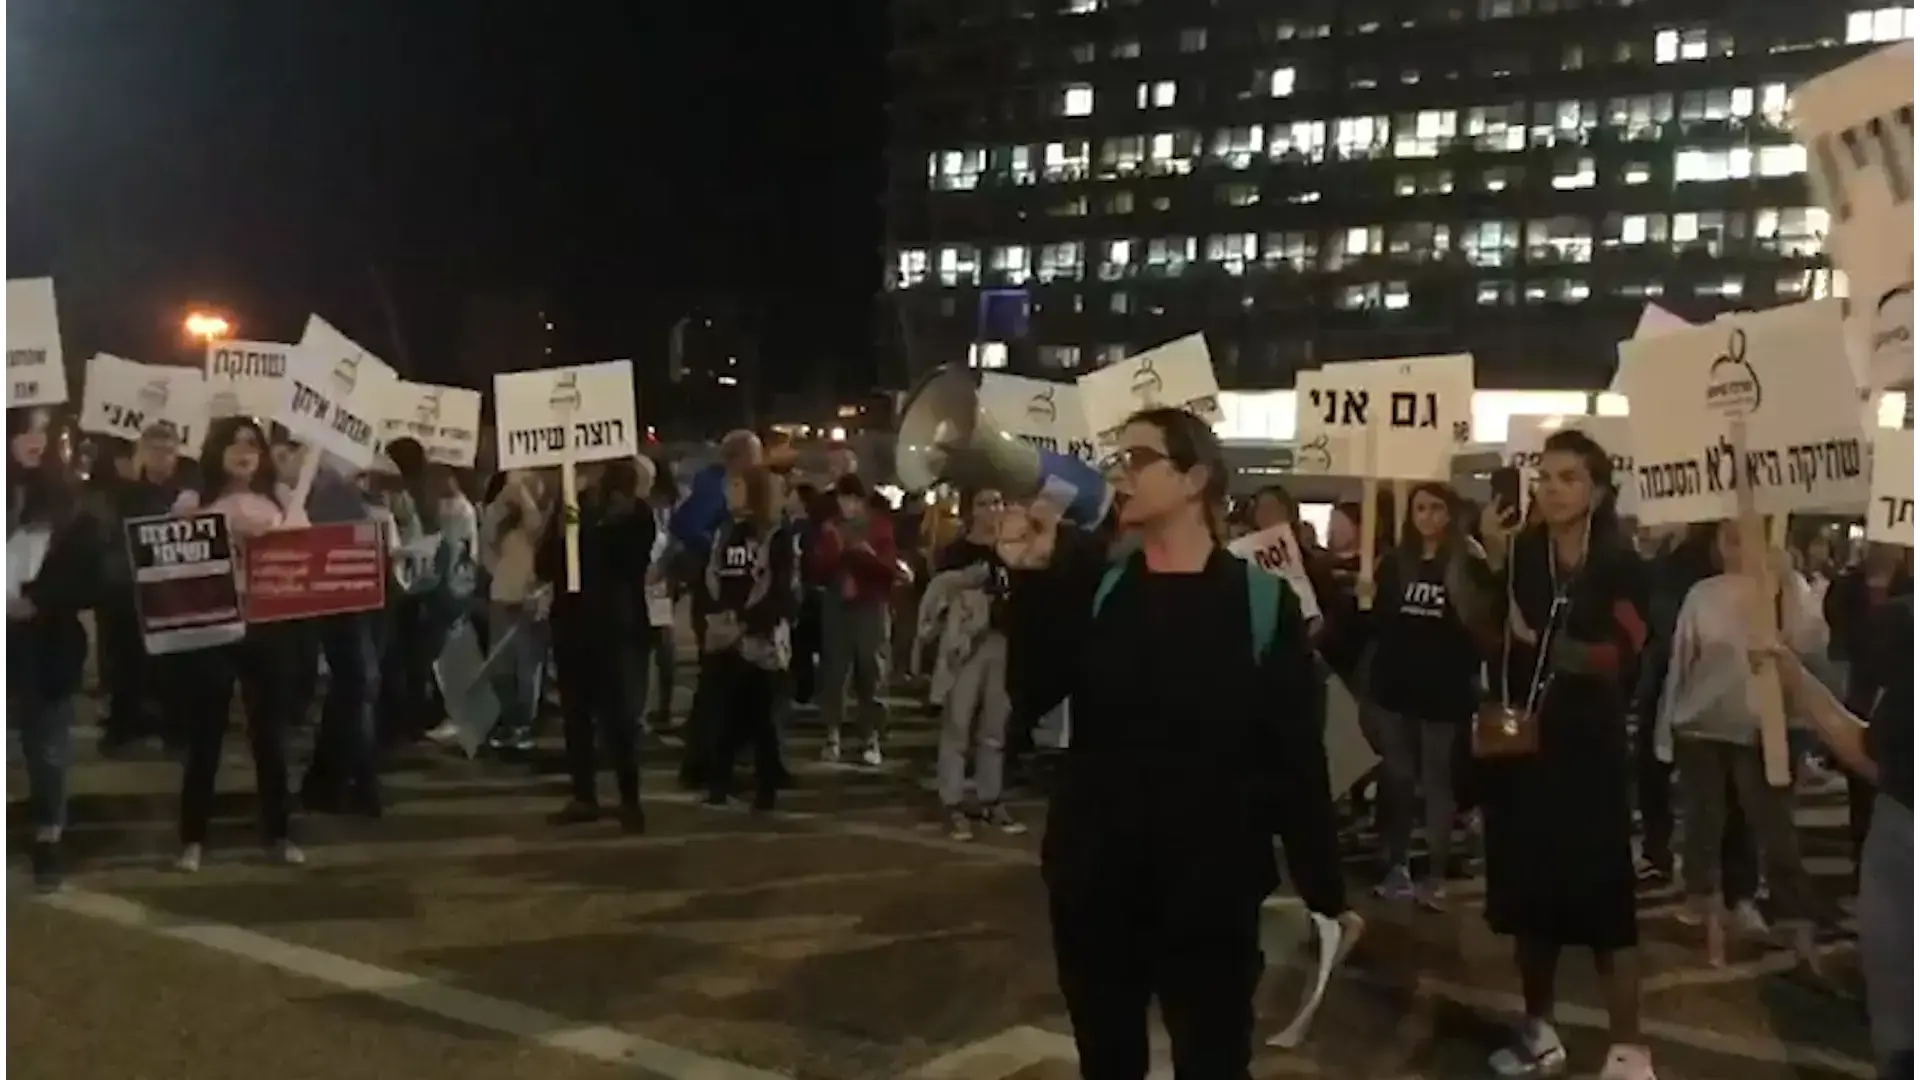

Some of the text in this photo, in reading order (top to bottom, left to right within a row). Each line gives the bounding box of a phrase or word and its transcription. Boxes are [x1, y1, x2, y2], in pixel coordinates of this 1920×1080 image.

[1309, 389, 1438, 430] גם אני
[575, 418, 623, 450] רוצה
[1639, 459, 1699, 500] הסכמה
[1705, 434, 1737, 492] לא
[1745, 449, 1782, 487] היא
[1787, 436, 1860, 493] שתיקה
